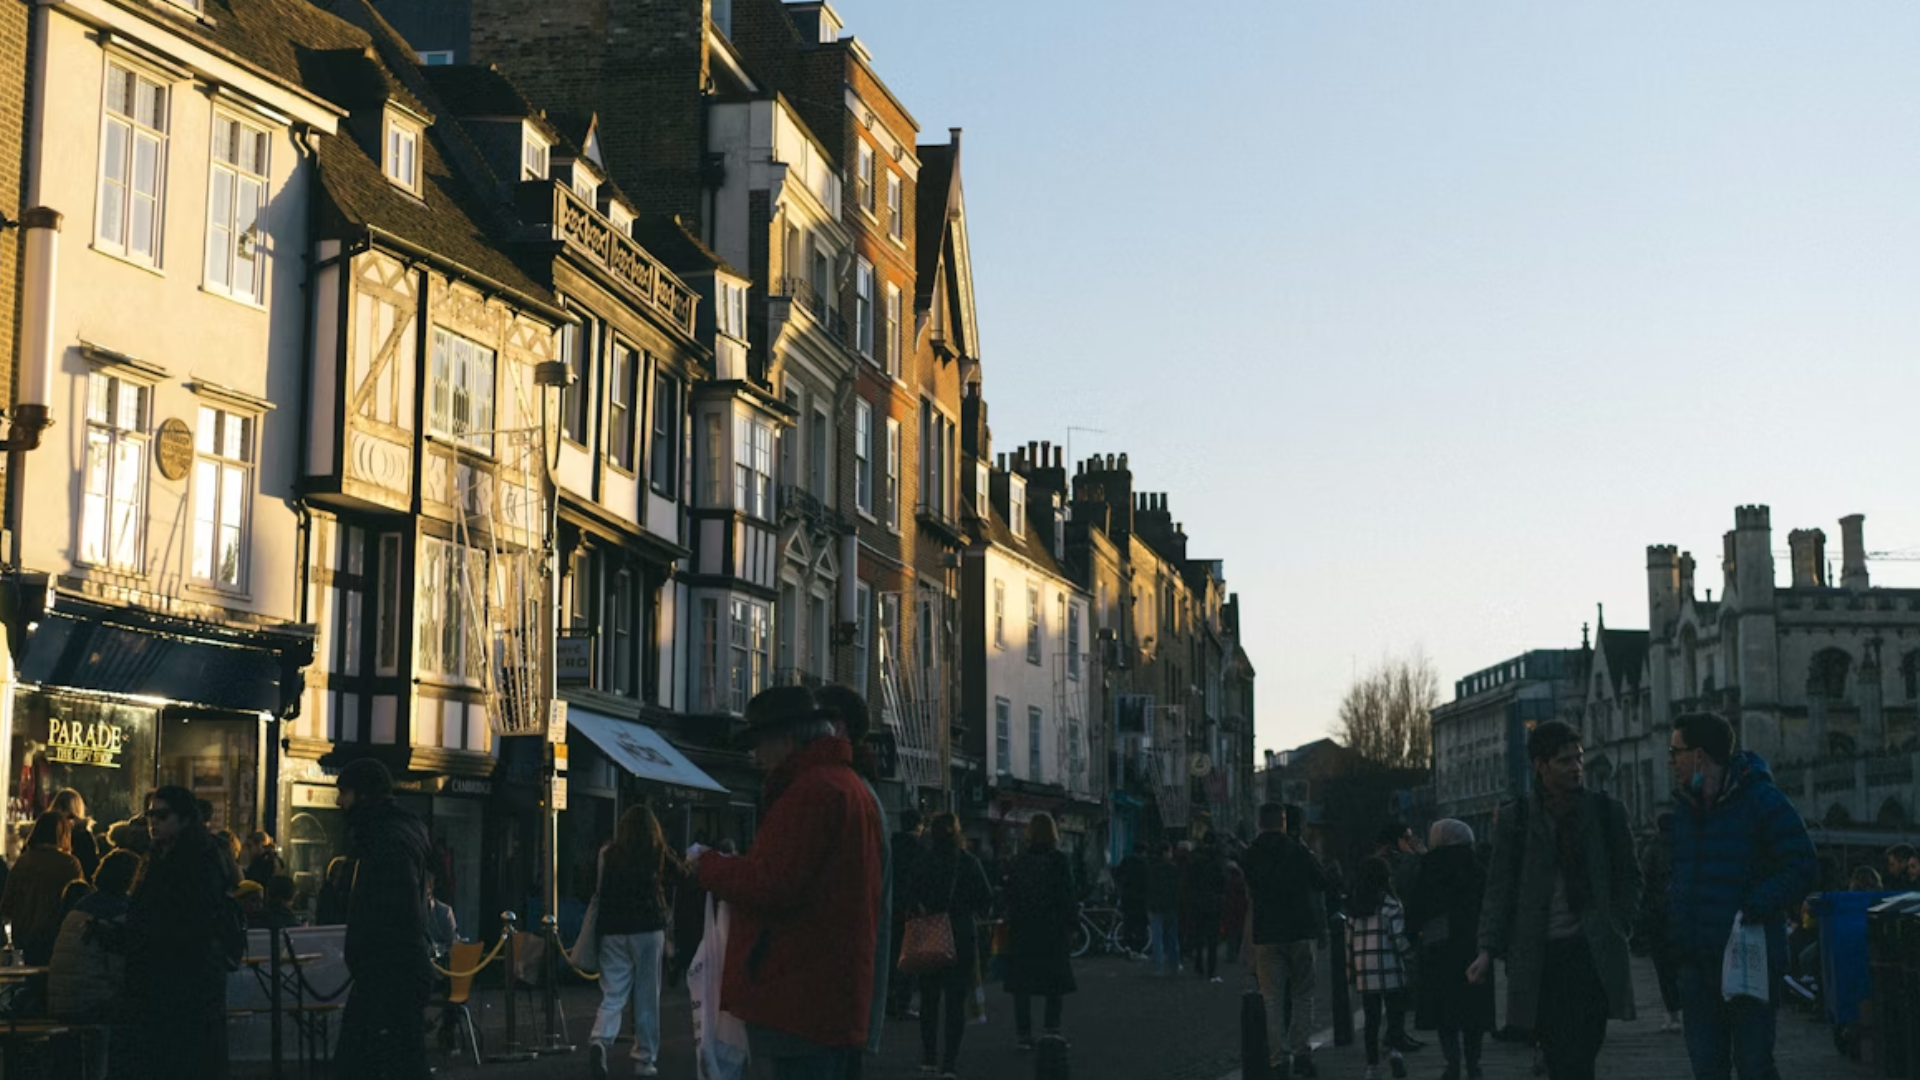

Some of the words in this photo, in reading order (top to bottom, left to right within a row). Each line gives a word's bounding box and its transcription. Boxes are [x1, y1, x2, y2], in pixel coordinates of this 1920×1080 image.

[48, 718, 122, 750] PARADE
[56, 747, 73, 760] THE
[452, 778, 492, 794] CAMBRIDGE
